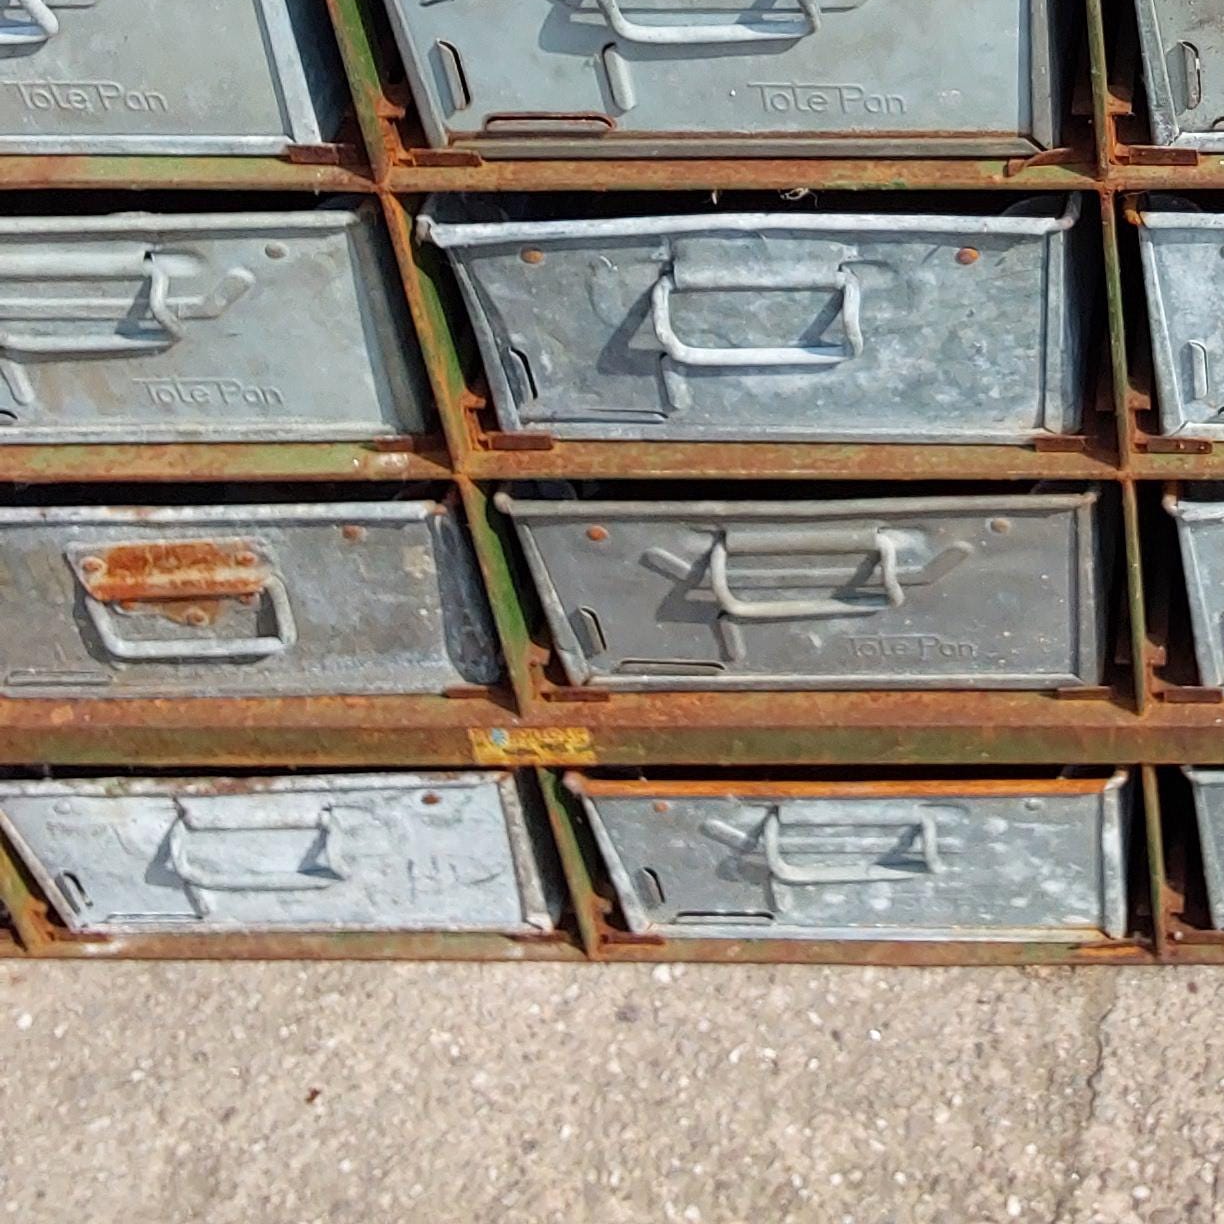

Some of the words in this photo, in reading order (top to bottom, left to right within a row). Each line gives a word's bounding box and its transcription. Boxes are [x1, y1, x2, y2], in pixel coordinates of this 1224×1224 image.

[1, 77, 92, 111] Tote
[96, 80, 168, 112] Pan
[747, 80, 829, 113] Tote
[838, 84, 906, 114] Pan
[131, 376, 210, 406] Tote
[216, 378, 283, 406] Pan
[843, 633, 908, 658] Tote
[918, 633, 977, 659] Pan
